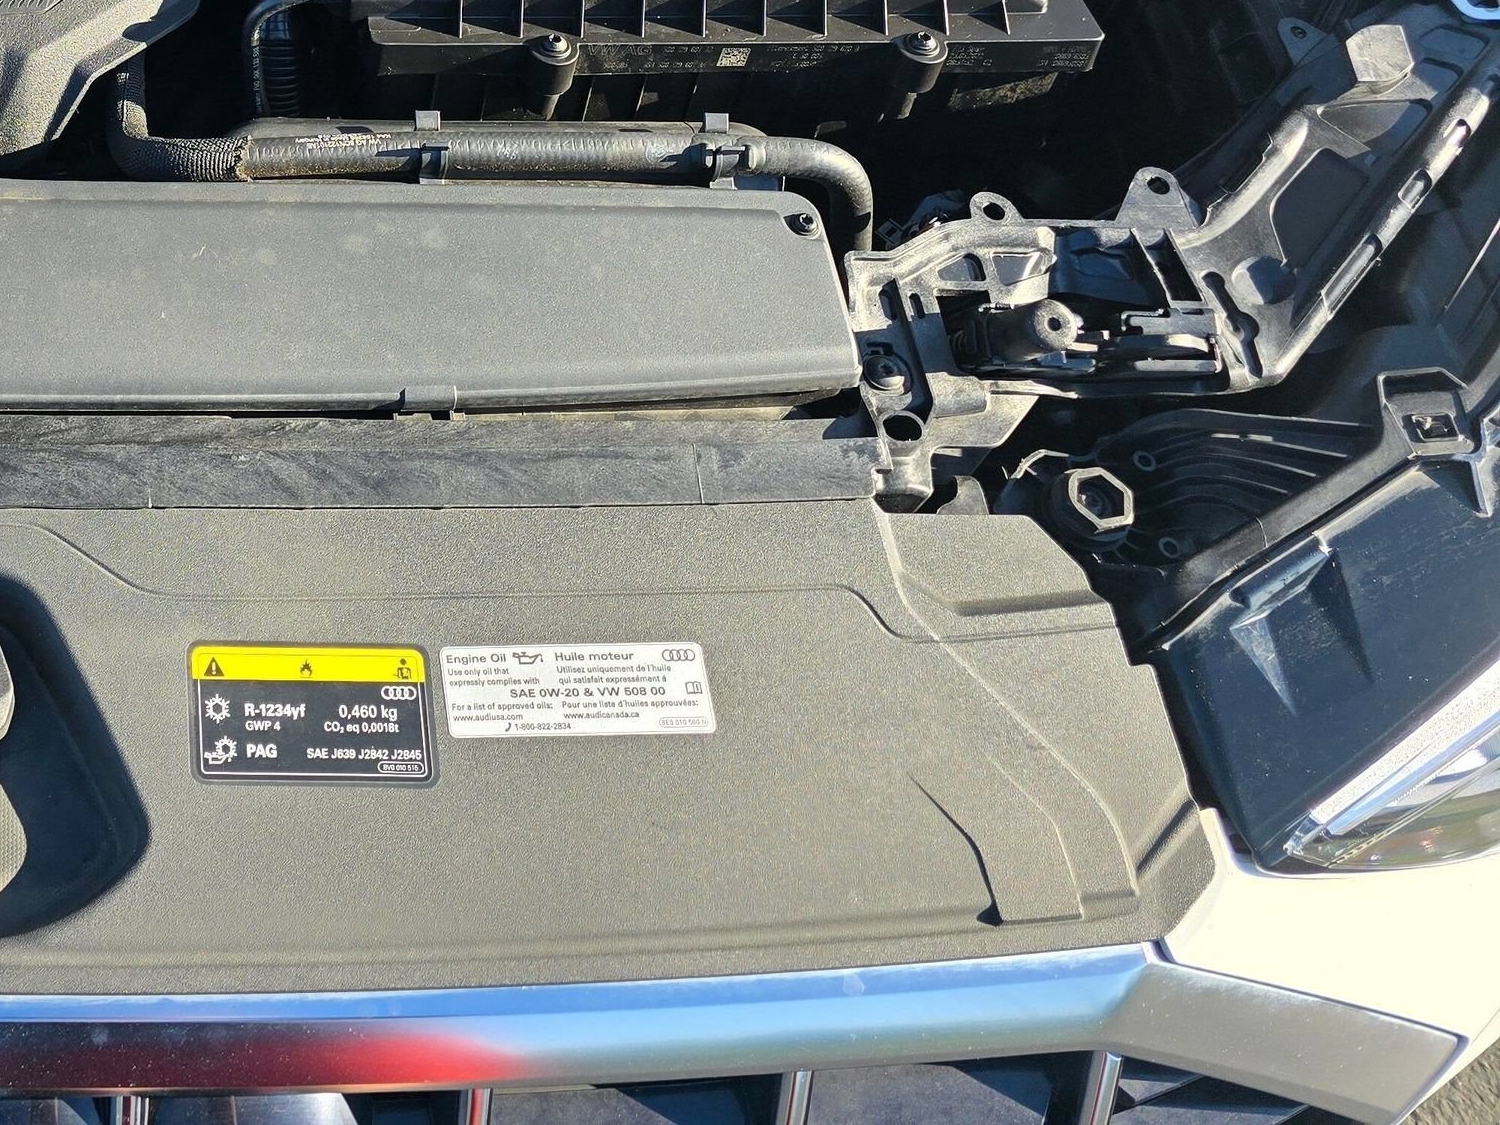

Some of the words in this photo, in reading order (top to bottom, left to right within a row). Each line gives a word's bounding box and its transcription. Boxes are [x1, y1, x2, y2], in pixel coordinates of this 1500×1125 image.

[588, 44, 620, 55] VW
[620, 44, 652, 55] AG
[446, 654, 487, 665] Engine
[491, 654, 506, 662] Oil
[555, 652, 585, 661] Huile
[589, 652, 634, 661] moteur
[464, 668, 480, 676] only
[494, 667, 509, 675] that
[587, 665, 634, 674] uniquement
[647, 664, 671, 672] l'huile
[450, 679, 485, 687] expressly
[487, 678, 521, 686] complies
[523, 677, 540, 685] with
[559, 677, 571, 685] qui
[573, 676, 603, 684] satisfait
[605, 675, 660, 684] expressément
[510, 688, 536, 698] SAE
[539, 688, 579, 697] 0W-20
[583, 688, 594, 697] &
[597, 687, 620, 696] VW
[624, 686, 647, 696] 508
[651, 686, 666, 695] 00
[452, 703, 464, 711] For
[488, 702, 496, 710] of
[498, 702, 534, 711] approved
[562, 701, 581, 709] Pour
[600, 700, 616, 708] liste
[618, 699, 649, 707] d'huiles
[244, 703, 307, 720] R-1234yf
[338, 705, 377, 719] 0,460
[381, 705, 398, 721] kg
[563, 711, 640, 719] www.audicanada.ca
[245, 721, 272, 732] GWP
[273, 721, 281, 731] 4
[346, 724, 359, 734] eq
[361, 722, 399, 733] 0,0018t
[515, 723, 571, 731] 1-800-822-2834
[246, 744, 277, 758] PAG
[307, 749, 328, 759] SAE
[331, 749, 356, 759] J639
[358, 749, 388, 760] J2842
[391, 749, 422, 760] J2845
